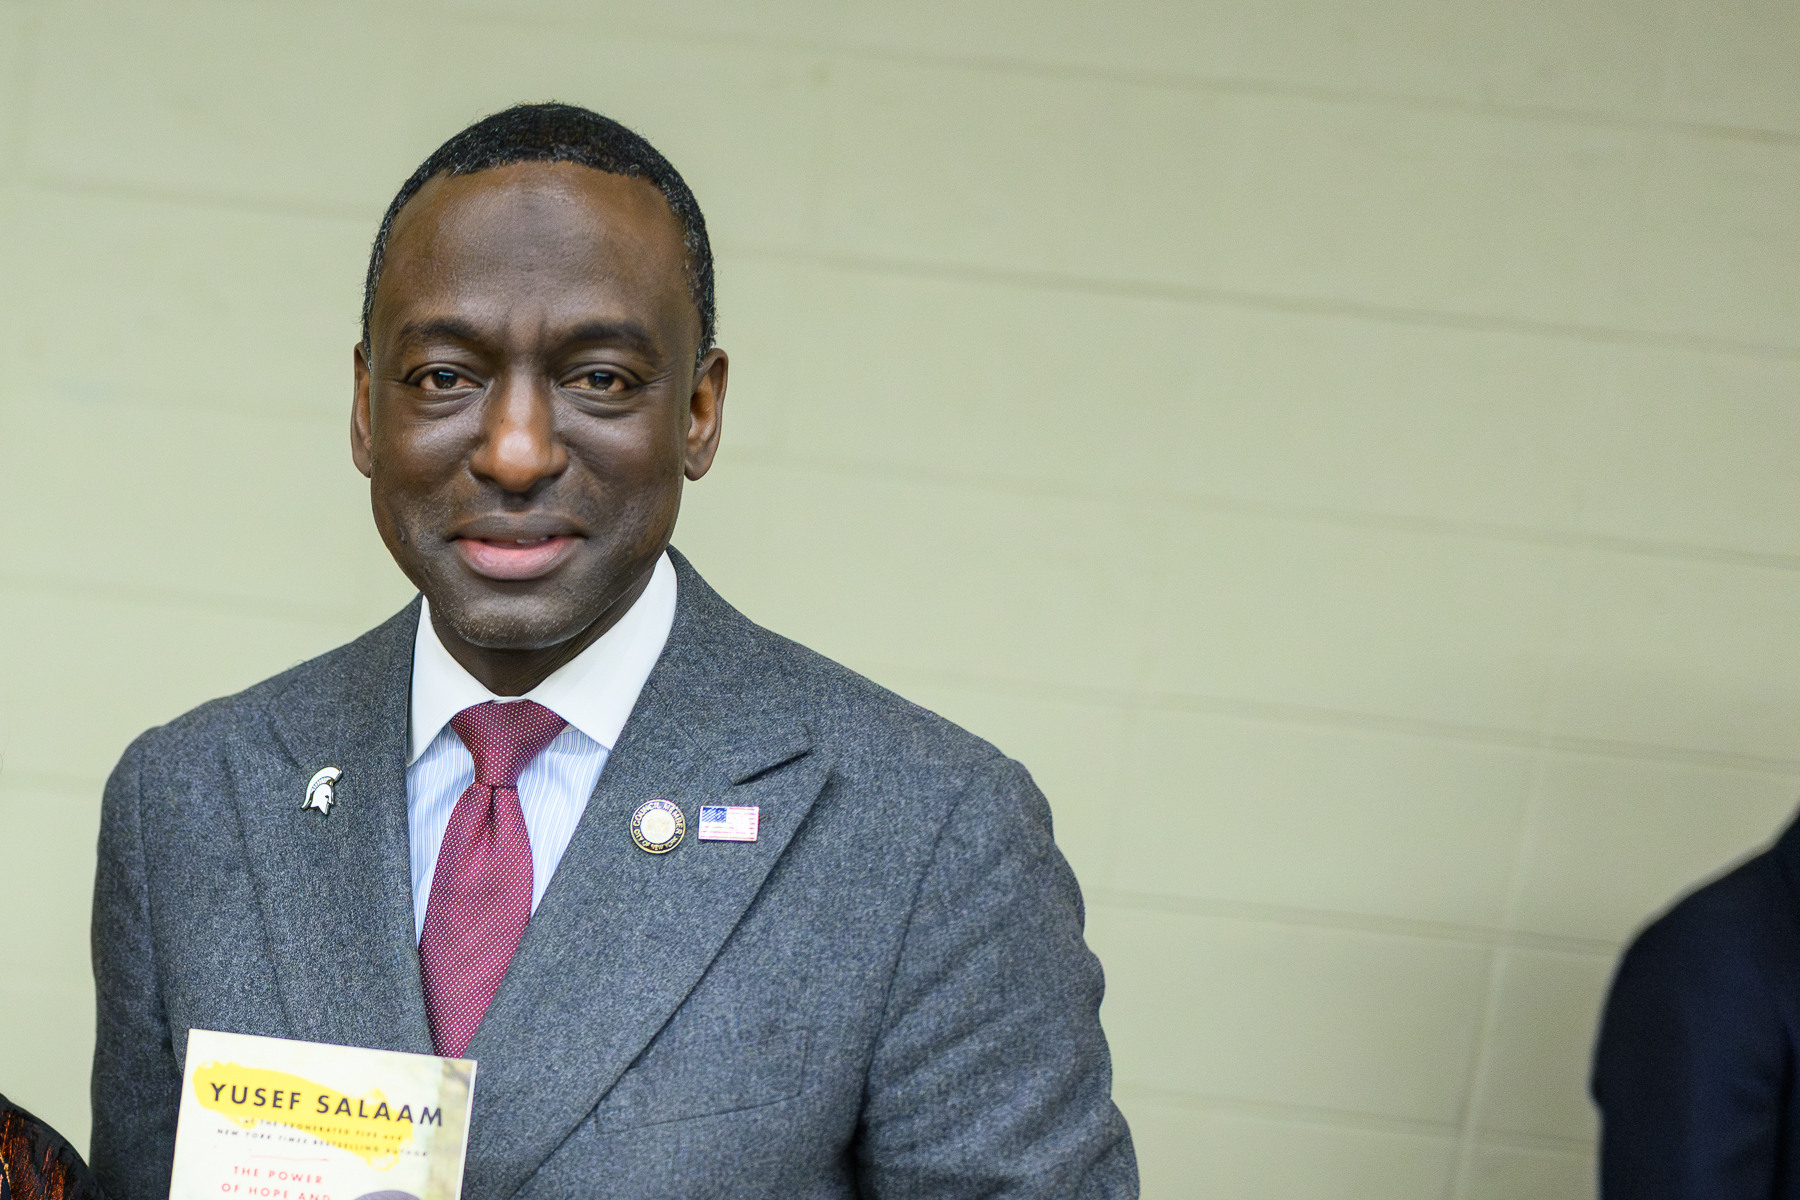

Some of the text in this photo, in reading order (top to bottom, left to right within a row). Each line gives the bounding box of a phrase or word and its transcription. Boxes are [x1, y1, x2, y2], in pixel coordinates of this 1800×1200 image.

[632, 801, 683, 835] COUNCIL MEMBER
[210, 1082, 443, 1127] YUSEF SALAAM
[245, 1131, 271, 1140] YORK
[234, 1165, 322, 1184] THE POWER
[221, 1183, 239, 1193] OF
[249, 1186, 288, 1199] HOPE
